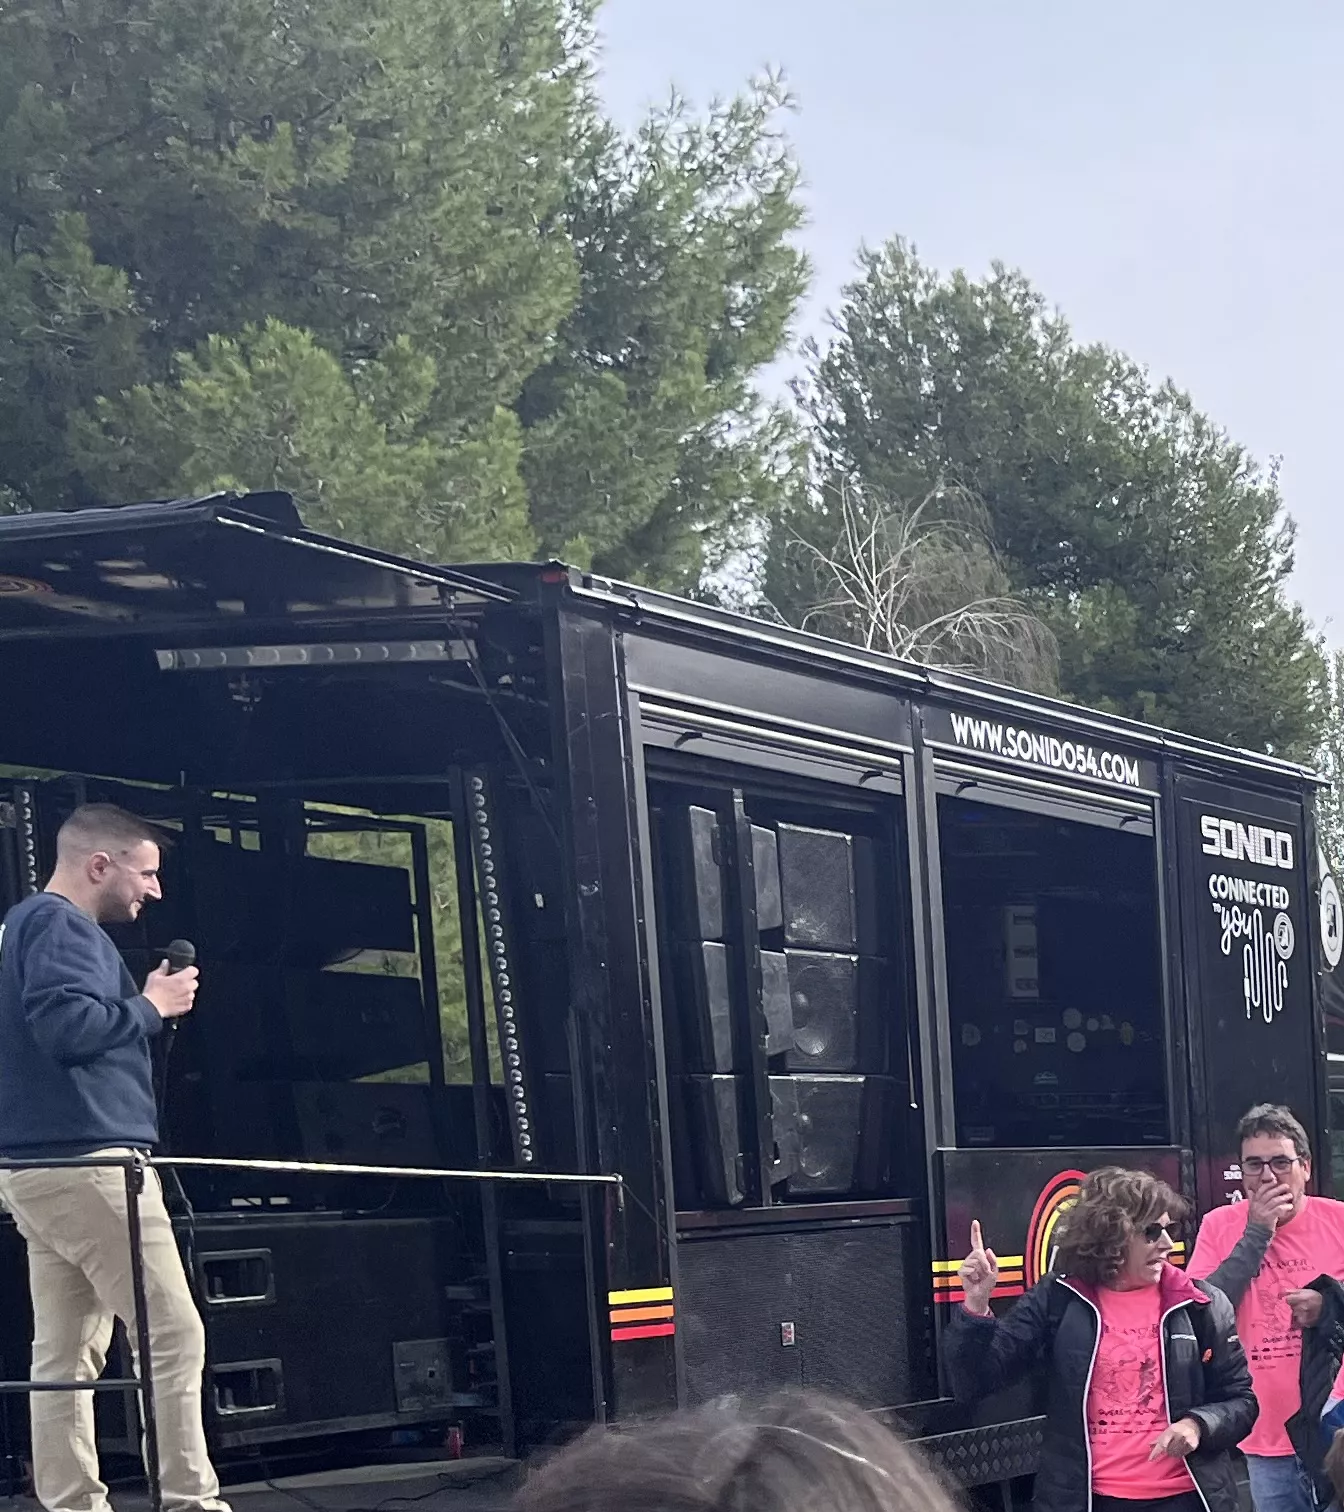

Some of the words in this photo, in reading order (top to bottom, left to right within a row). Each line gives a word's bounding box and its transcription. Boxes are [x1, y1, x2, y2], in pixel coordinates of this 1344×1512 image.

[951, 712, 1140, 787] WWW.SONIDO54.COM
[1201, 815, 1294, 869] SONIDO
[1209, 873, 1290, 910] CONNECTED
